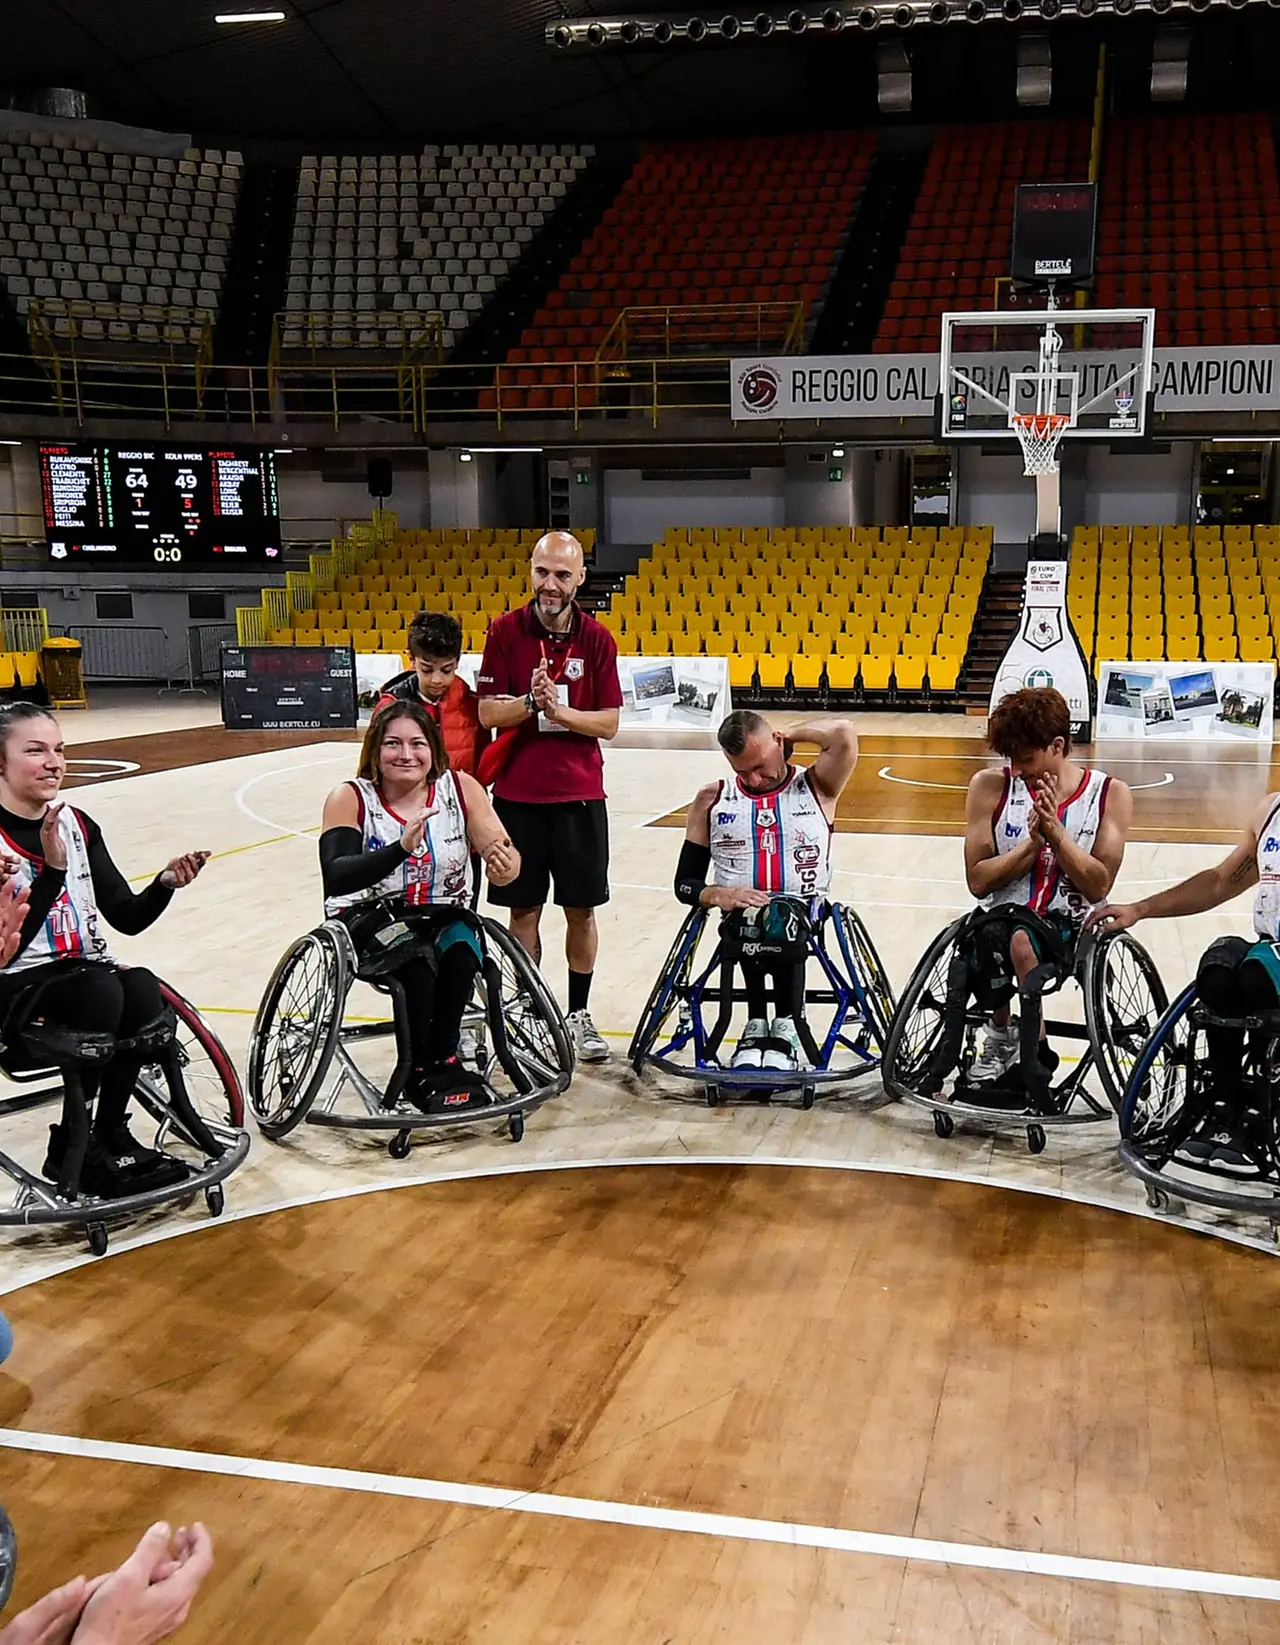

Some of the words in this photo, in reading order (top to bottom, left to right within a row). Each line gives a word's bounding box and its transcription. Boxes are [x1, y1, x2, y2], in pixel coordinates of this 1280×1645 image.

[792, 369, 878, 402] REGGIO
[886, 365, 1011, 402] CALBRIA
[1021, 362, 1121, 401] SLUTA
[125, 473, 148, 488] 64
[175, 474, 197, 489] 49
[135, 498, 142, 508] 1
[184, 498, 192, 508] 5
[154, 547, 181, 562] 0:0
[223, 669, 247, 679] HOME
[330, 668, 353, 678] GUEST
[761, 831, 776, 855] 4
[407, 864, 432, 881] 23
